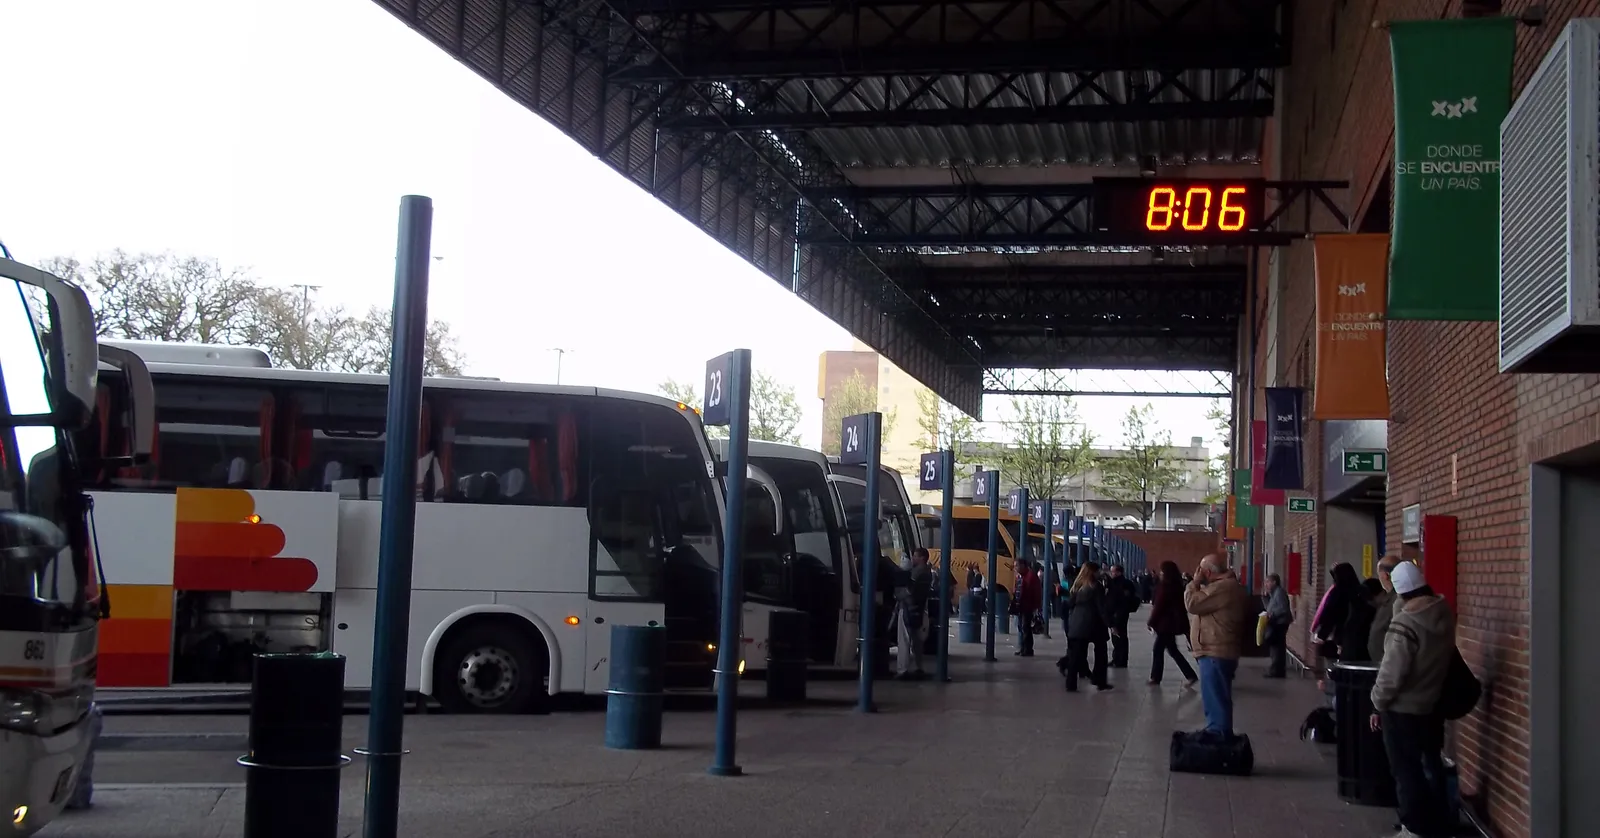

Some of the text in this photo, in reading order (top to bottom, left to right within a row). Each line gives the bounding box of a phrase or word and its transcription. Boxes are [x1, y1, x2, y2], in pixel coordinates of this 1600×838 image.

[1427, 144, 1483, 158] DONDE
[1397, 162, 1417, 175] SE
[1421, 174, 1482, 190] UN PAÍS.
[1145, 186, 1247, 231] 8:06
[708, 369, 722, 408] 23
[846, 425, 859, 453] 24
[924, 460, 936, 481] 25
[976, 477, 985, 495] 26
[1010, 494, 1018, 510] 27
[1034, 505, 1042, 519] 28
[1052, 513, 1060, 526] 29
[24, 639, 46, 660] 862
